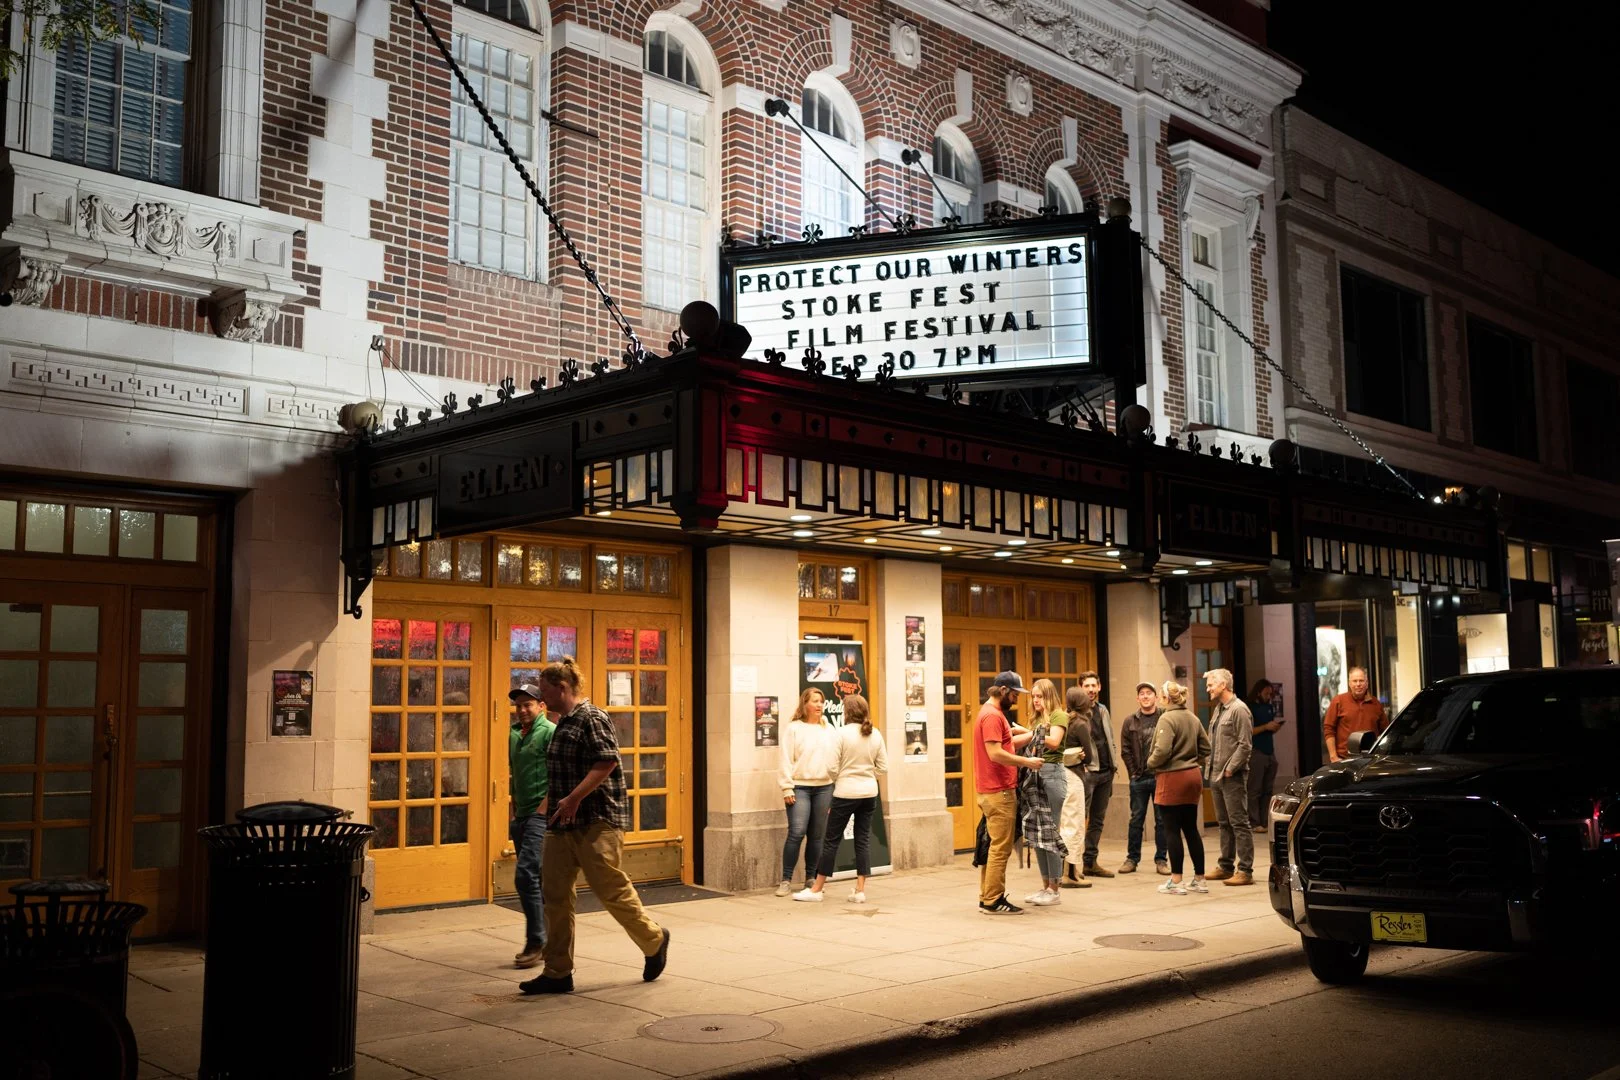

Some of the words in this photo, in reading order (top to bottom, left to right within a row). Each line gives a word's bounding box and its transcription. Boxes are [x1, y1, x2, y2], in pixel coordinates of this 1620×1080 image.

[739, 264, 861, 294] PROTECT
[876, 258, 931, 281] OUR
[948, 243, 1082, 274] WINTERS
[782, 291, 882, 320] STOKE
[910, 281, 1000, 309] FEST
[788, 324, 862, 350] FILM
[884, 310, 1041, 341] FESTIVAL
[830, 354, 868, 376] EP
[882, 350, 916, 372] 30
[933, 344, 997, 368] 7PM
[457, 454, 550, 503] ELLEN
[1188, 503, 1257, 538] ELLEN
[828, 604, 840, 617] 17
[1375, 912, 1412, 935] Ressler
